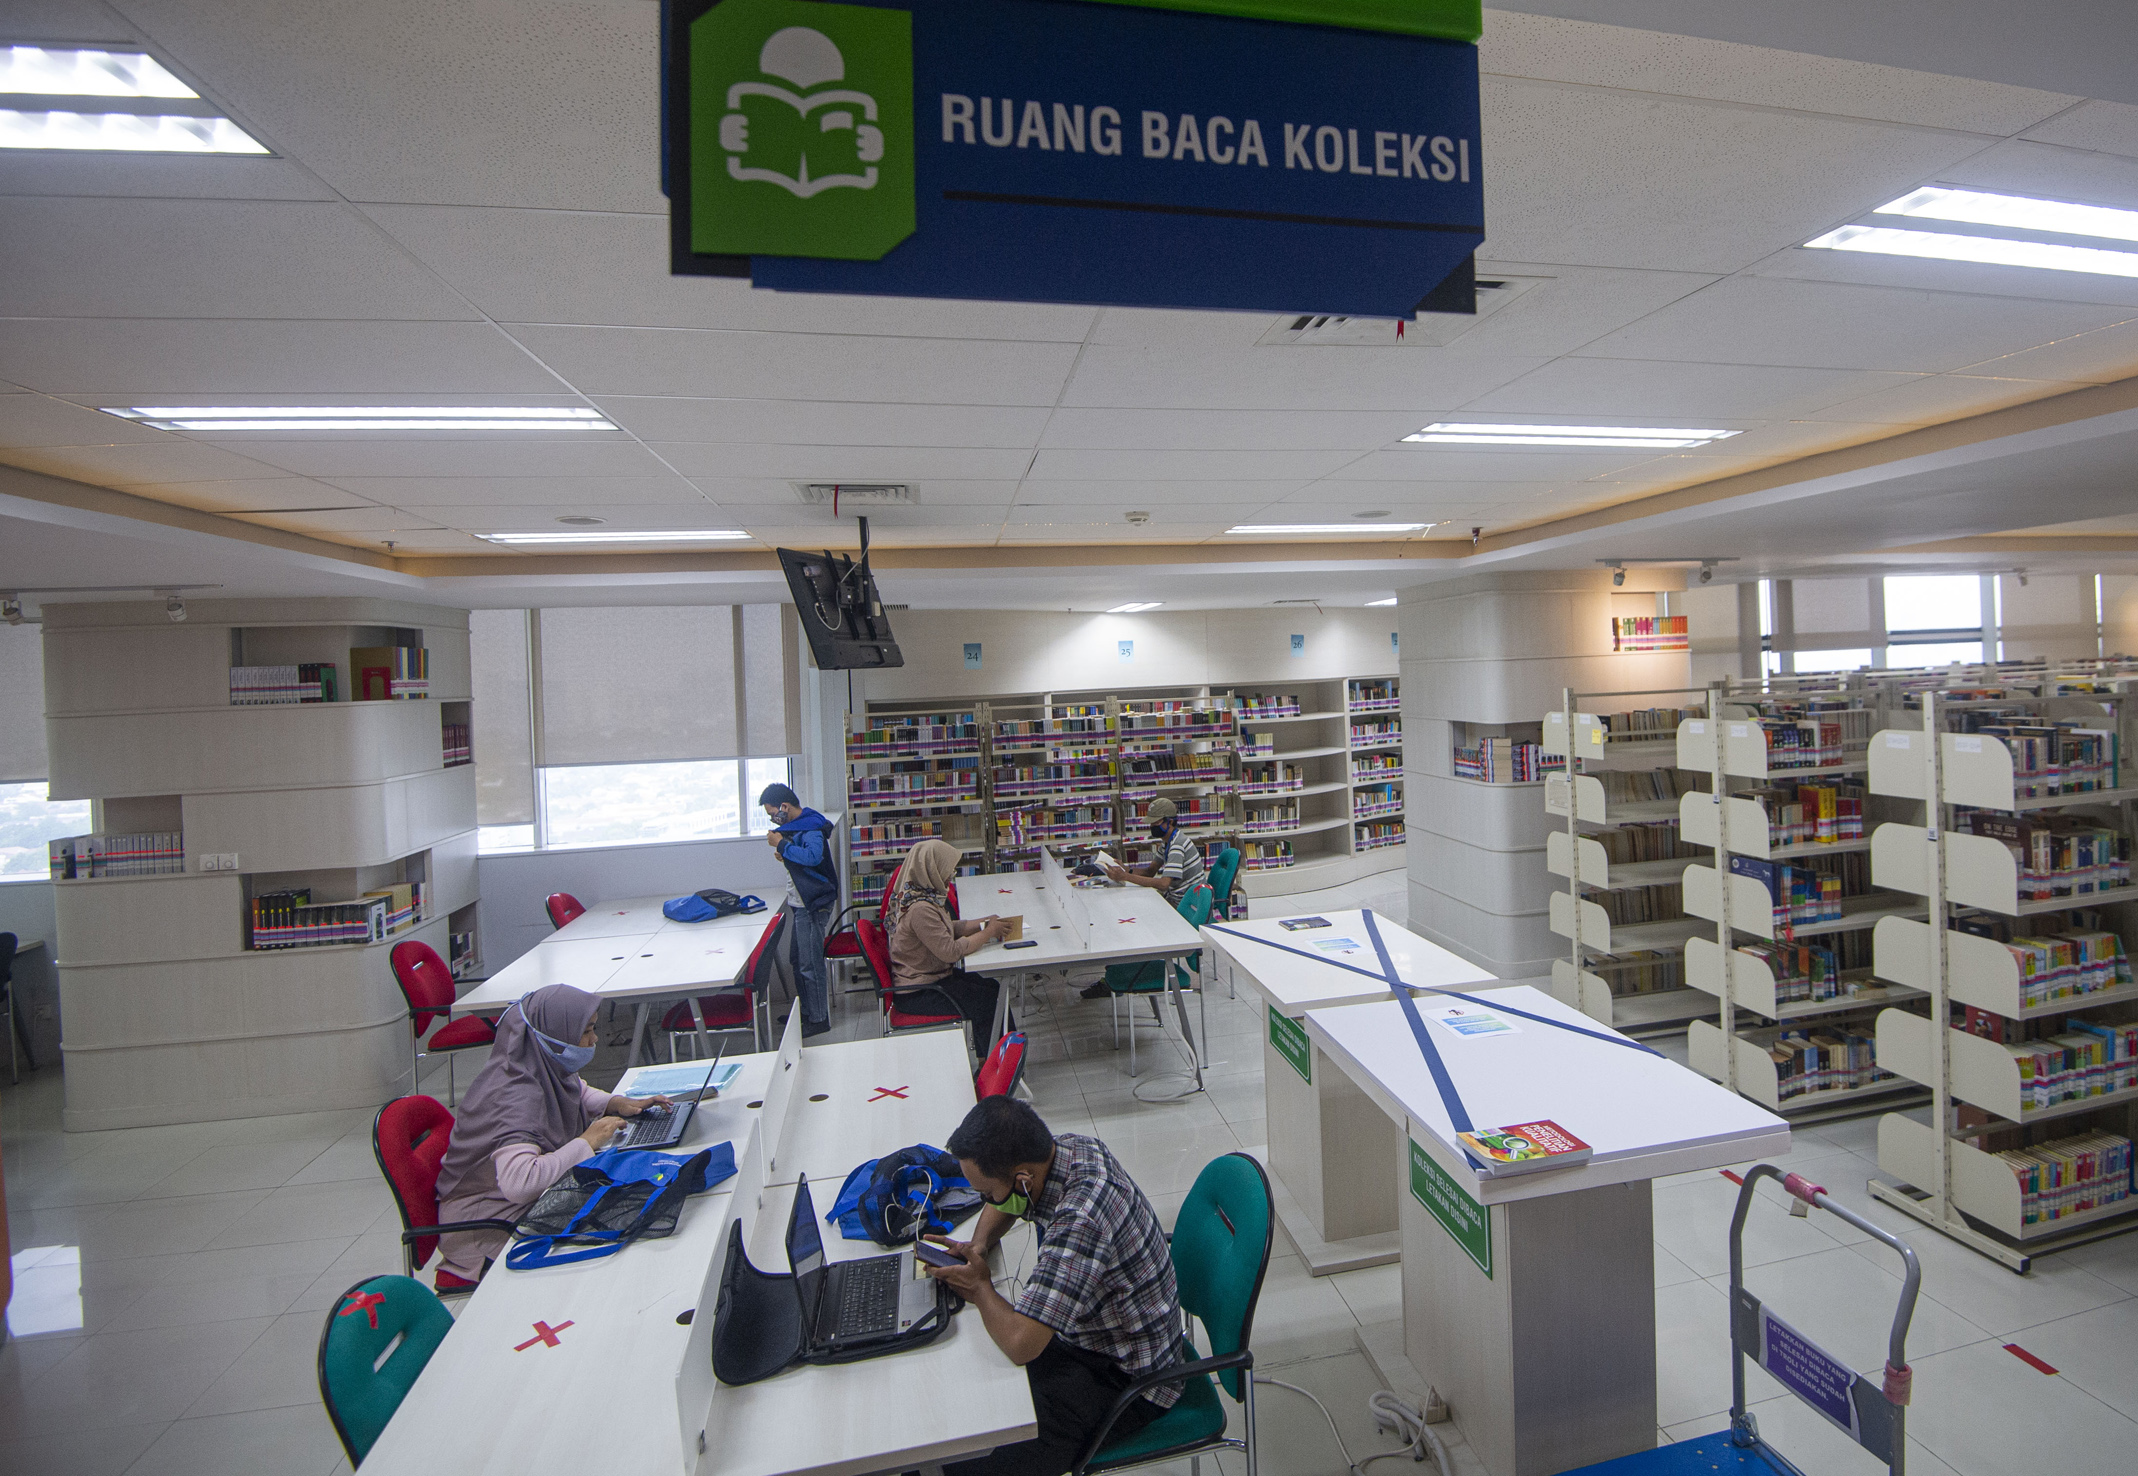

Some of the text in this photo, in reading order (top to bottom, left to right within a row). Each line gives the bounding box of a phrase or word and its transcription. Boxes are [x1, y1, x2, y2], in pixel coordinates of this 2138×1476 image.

[941, 93, 1471, 183] RUANG BACA KOLEKSI
[966, 652, 979, 662] 24
[1121, 648, 1131, 658] 25
[1293, 640, 1303, 649] 26
[1520, 1126, 1563, 1153] KUALITATIF
[1530, 1124, 1573, 1151] PENELITIAN
[1413, 1150, 1483, 1230] KOLEKSI SELESAI DIBACA
[1426, 1179, 1469, 1233] LETAKAN DISINI
[1769, 1322, 1847, 1382] LETAKKAN BUKU YANG
[1780, 1340, 1835, 1385] SELESAI DIBACA
[1771, 1343, 1846, 1403] DI TROLI YANG SUDAH
[1785, 1365, 1829, 1401] DISEDIAKAN.
